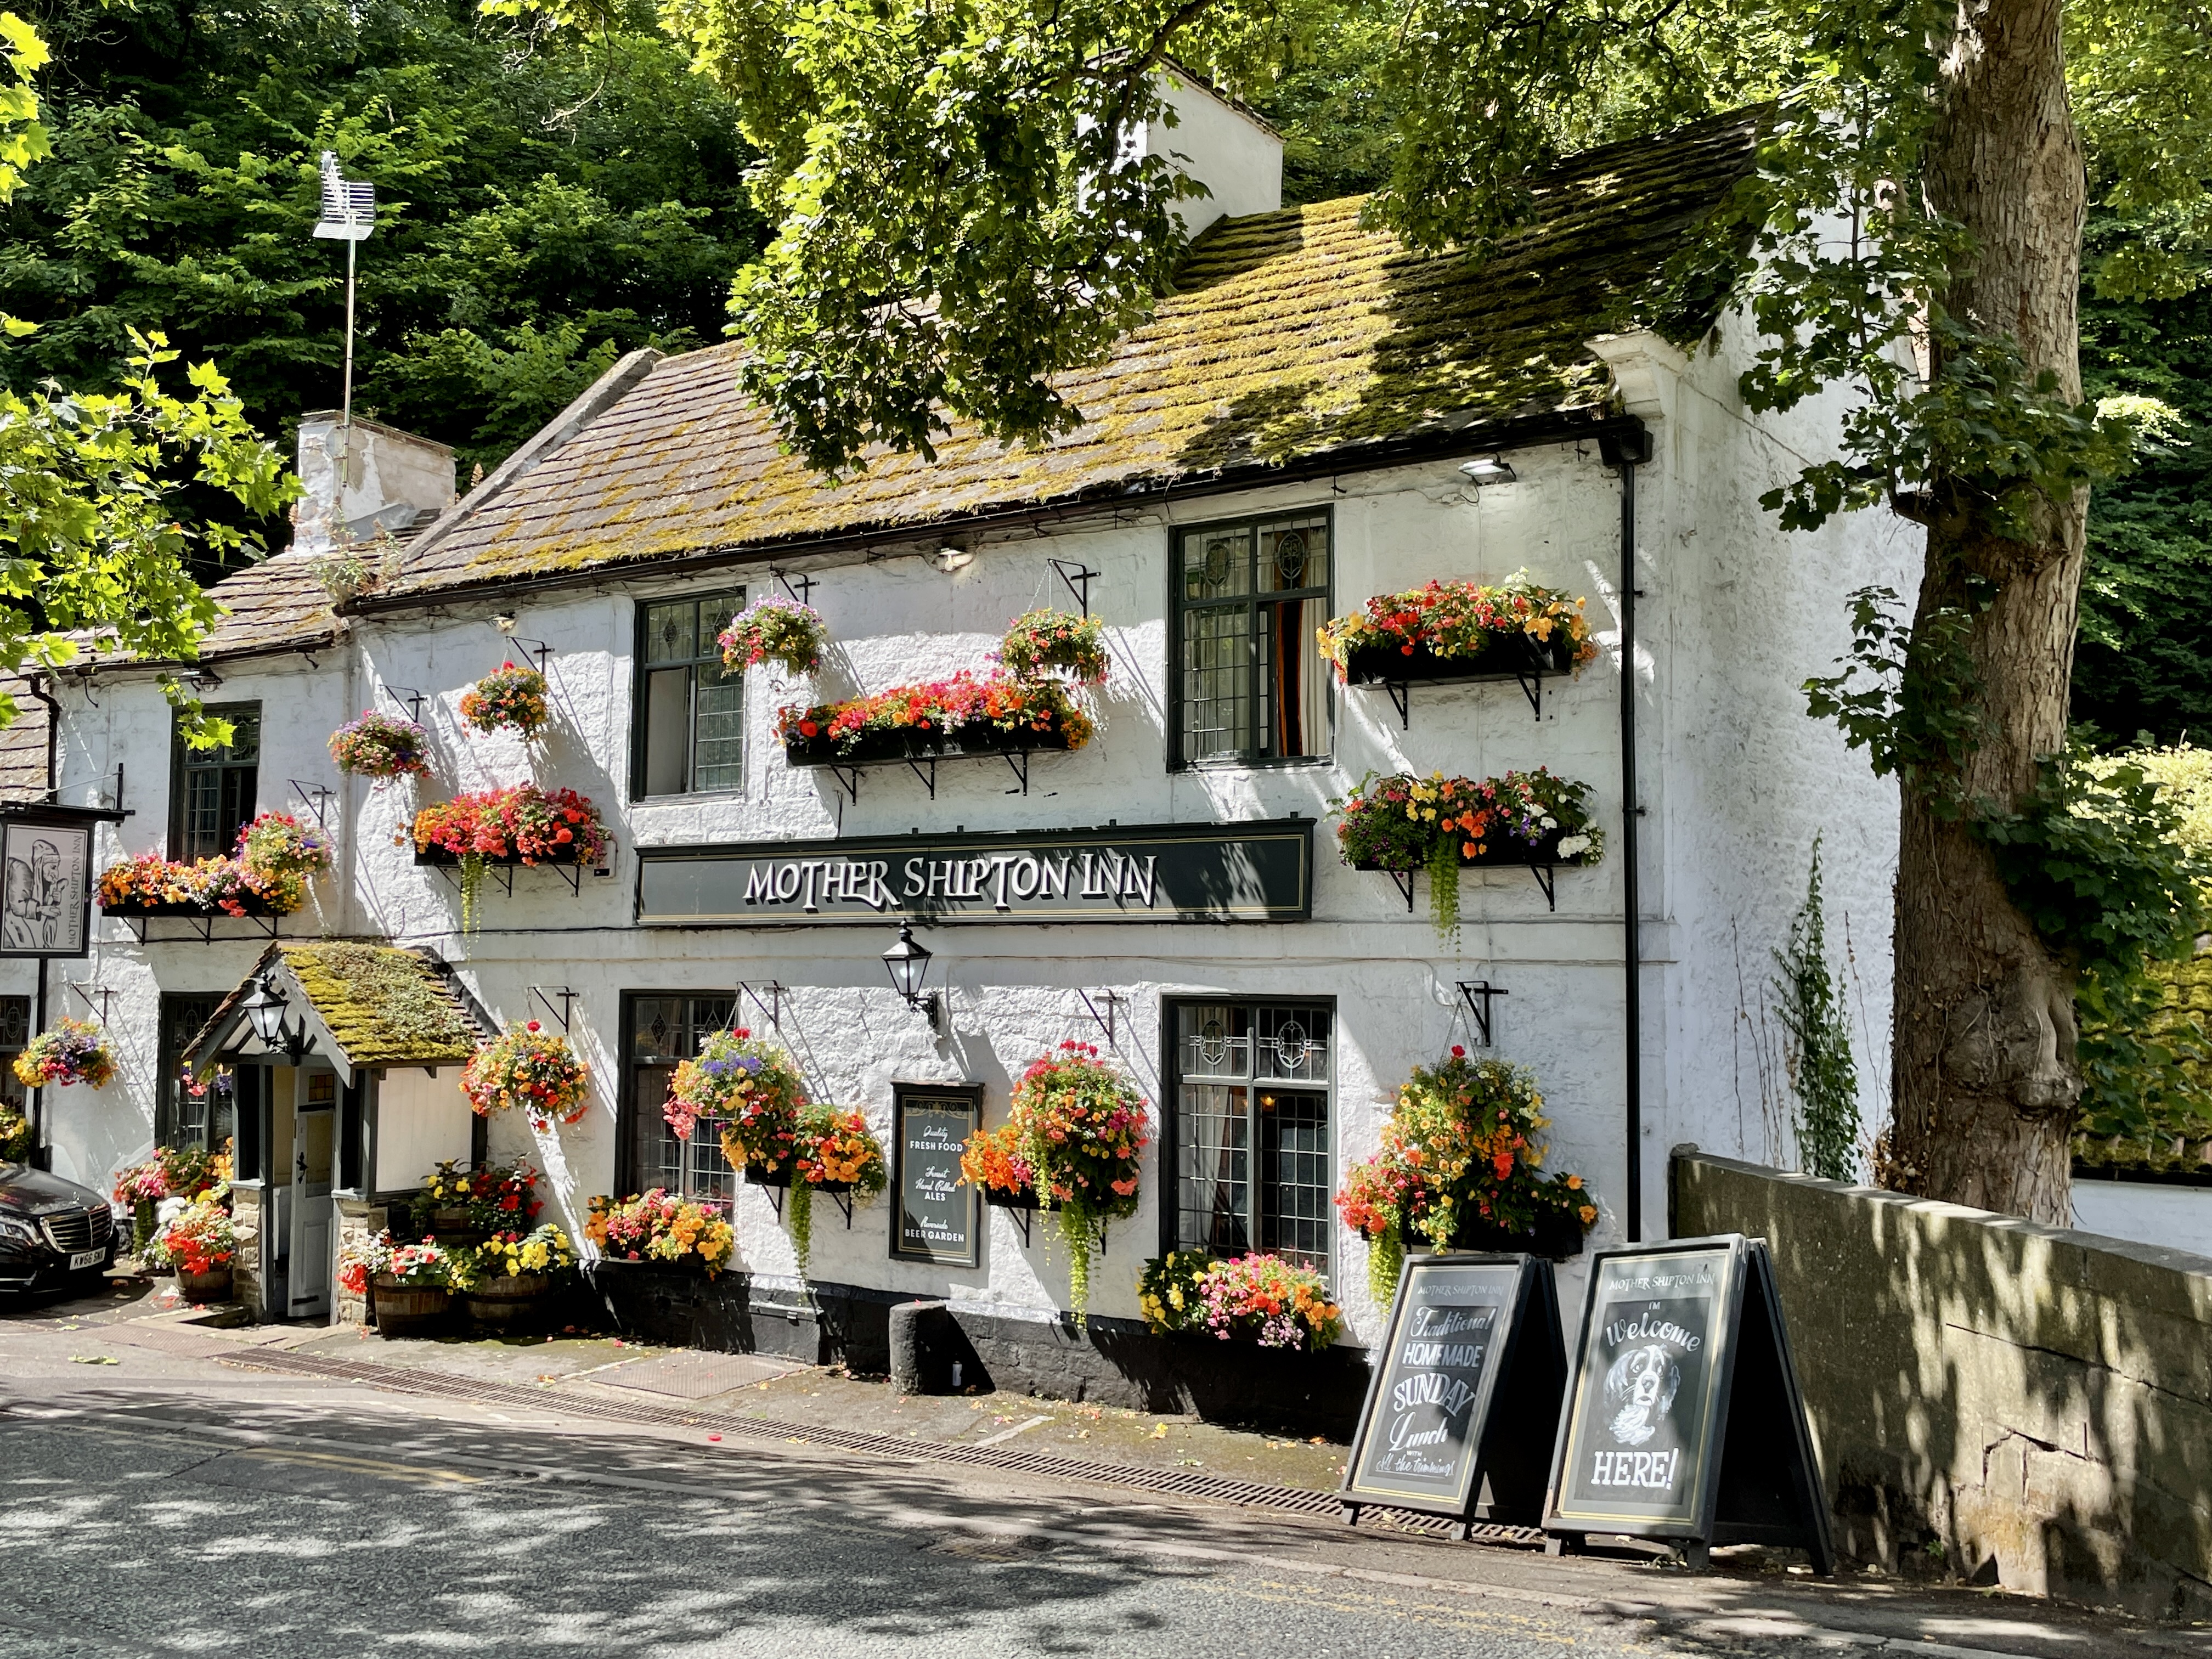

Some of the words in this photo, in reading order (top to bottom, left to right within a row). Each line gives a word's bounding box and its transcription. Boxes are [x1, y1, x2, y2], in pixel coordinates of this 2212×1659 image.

[72, 835, 83, 854] INN
[70, 856, 81, 900] SHIPTON
[742, 860, 901, 910] MOTHER
[903, 855, 1072, 908] SHIPTON
[1079, 853, 1158, 907] INN
[69, 901, 79, 946] MOTHER
[910, 1140, 935, 1150] FRESH
[938, 1142, 963, 1152] FOOD
[923, 1125, 948, 1142] Quality
[924, 1192, 946, 1201] ALES
[905, 1229, 926, 1238] BEER
[928, 1231, 964, 1242] GARDEN
[1417, 1285, 1452, 1296] MOTHER
[1452, 1284, 1487, 1296] SHIPTON
[1488, 1285, 1505, 1296] INN
[1609, 1277, 1651, 1291] MOTHER
[1652, 1274, 1695, 1288] SHIPTON
[1696, 1272, 1716, 1285] INN
[1410, 1306, 1497, 1337] Traditional
[1606, 1312, 1701, 1352] Welcome
[1393, 1372, 1475, 1417] SUNDAY
[1389, 1412, 1448, 1451] Lunch
[1375, 1453, 1394, 1471] All
[1395, 1454, 1412, 1472] the
[1590, 1448, 1679, 1490] HERE!
